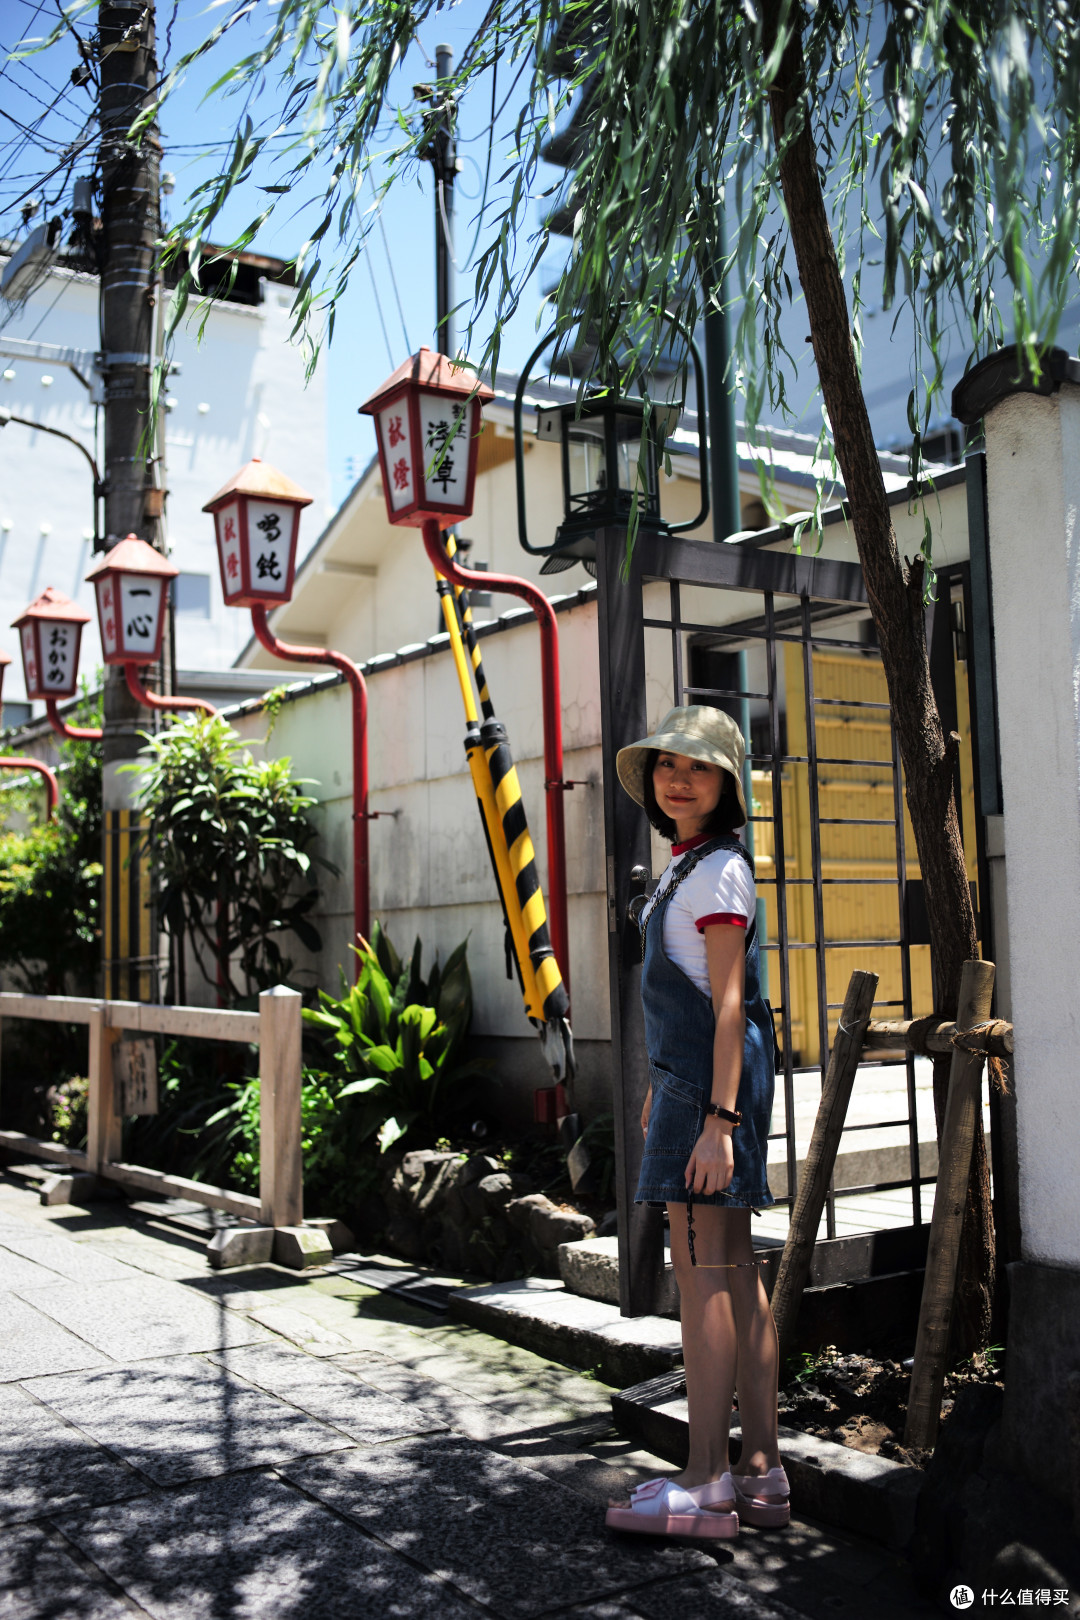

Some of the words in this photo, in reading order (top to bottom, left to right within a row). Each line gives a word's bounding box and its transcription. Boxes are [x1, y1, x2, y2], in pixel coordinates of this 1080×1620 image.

[127, 589, 153, 638] 一心
[47, 627, 67, 684] おかめ
